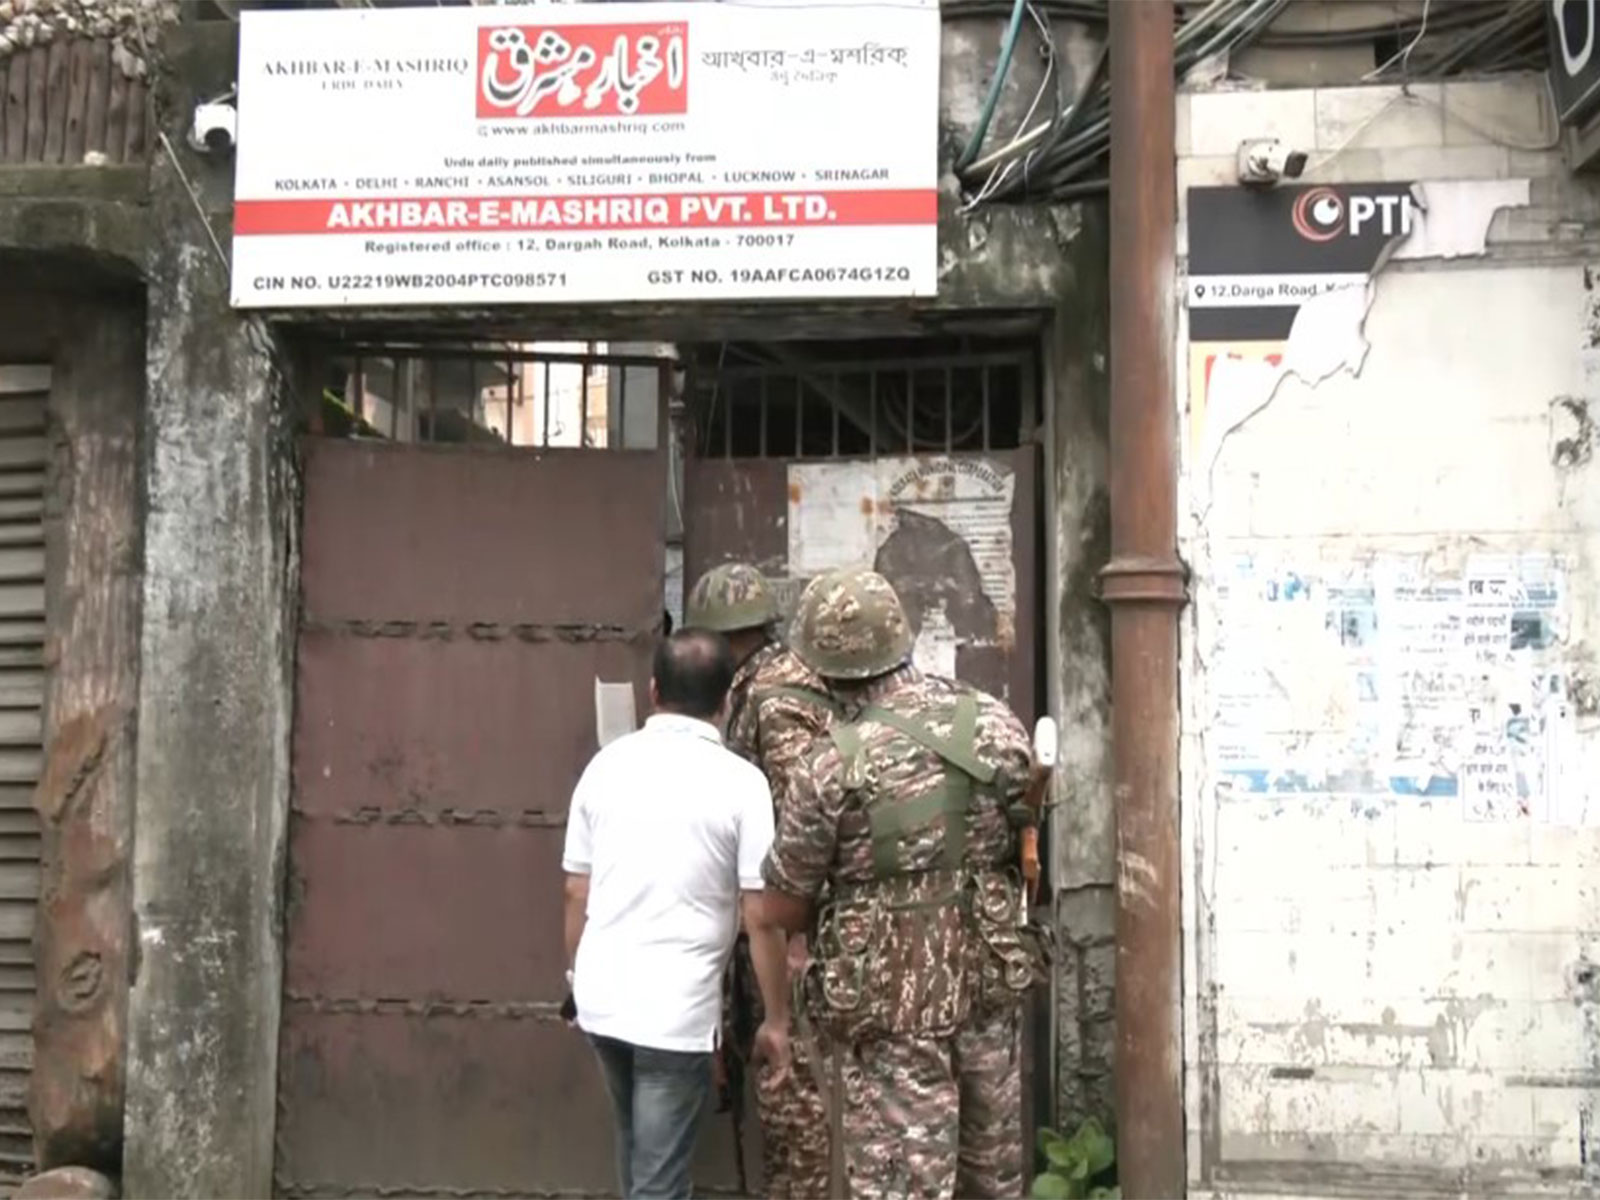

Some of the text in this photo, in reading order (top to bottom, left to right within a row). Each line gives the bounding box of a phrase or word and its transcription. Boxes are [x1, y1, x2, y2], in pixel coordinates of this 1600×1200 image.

[443, 152, 717, 169] Urdu daily published simultaneously from
[274, 168, 889, 191] KOLKATA DELHI RANCHI ASANSOL SILIGURI BHOPAL LUCKNOW SRINAGAR
[326, 193, 838, 229] AKHBAR-E-MASHRIQ PVT. LTD.
[364, 239, 451, 255] Registered
[455, 239, 501, 252] office
[545, 238, 603, 252] Dargah
[607, 236, 653, 251] Road,
[657, 234, 721, 249] Kolkata
[736, 233, 795, 247] 700017
[252, 273, 567, 291] CIN NO. U22219WB2004PTC098571
[646, 269, 685, 285] GST
[690, 268, 723, 284] NO.
